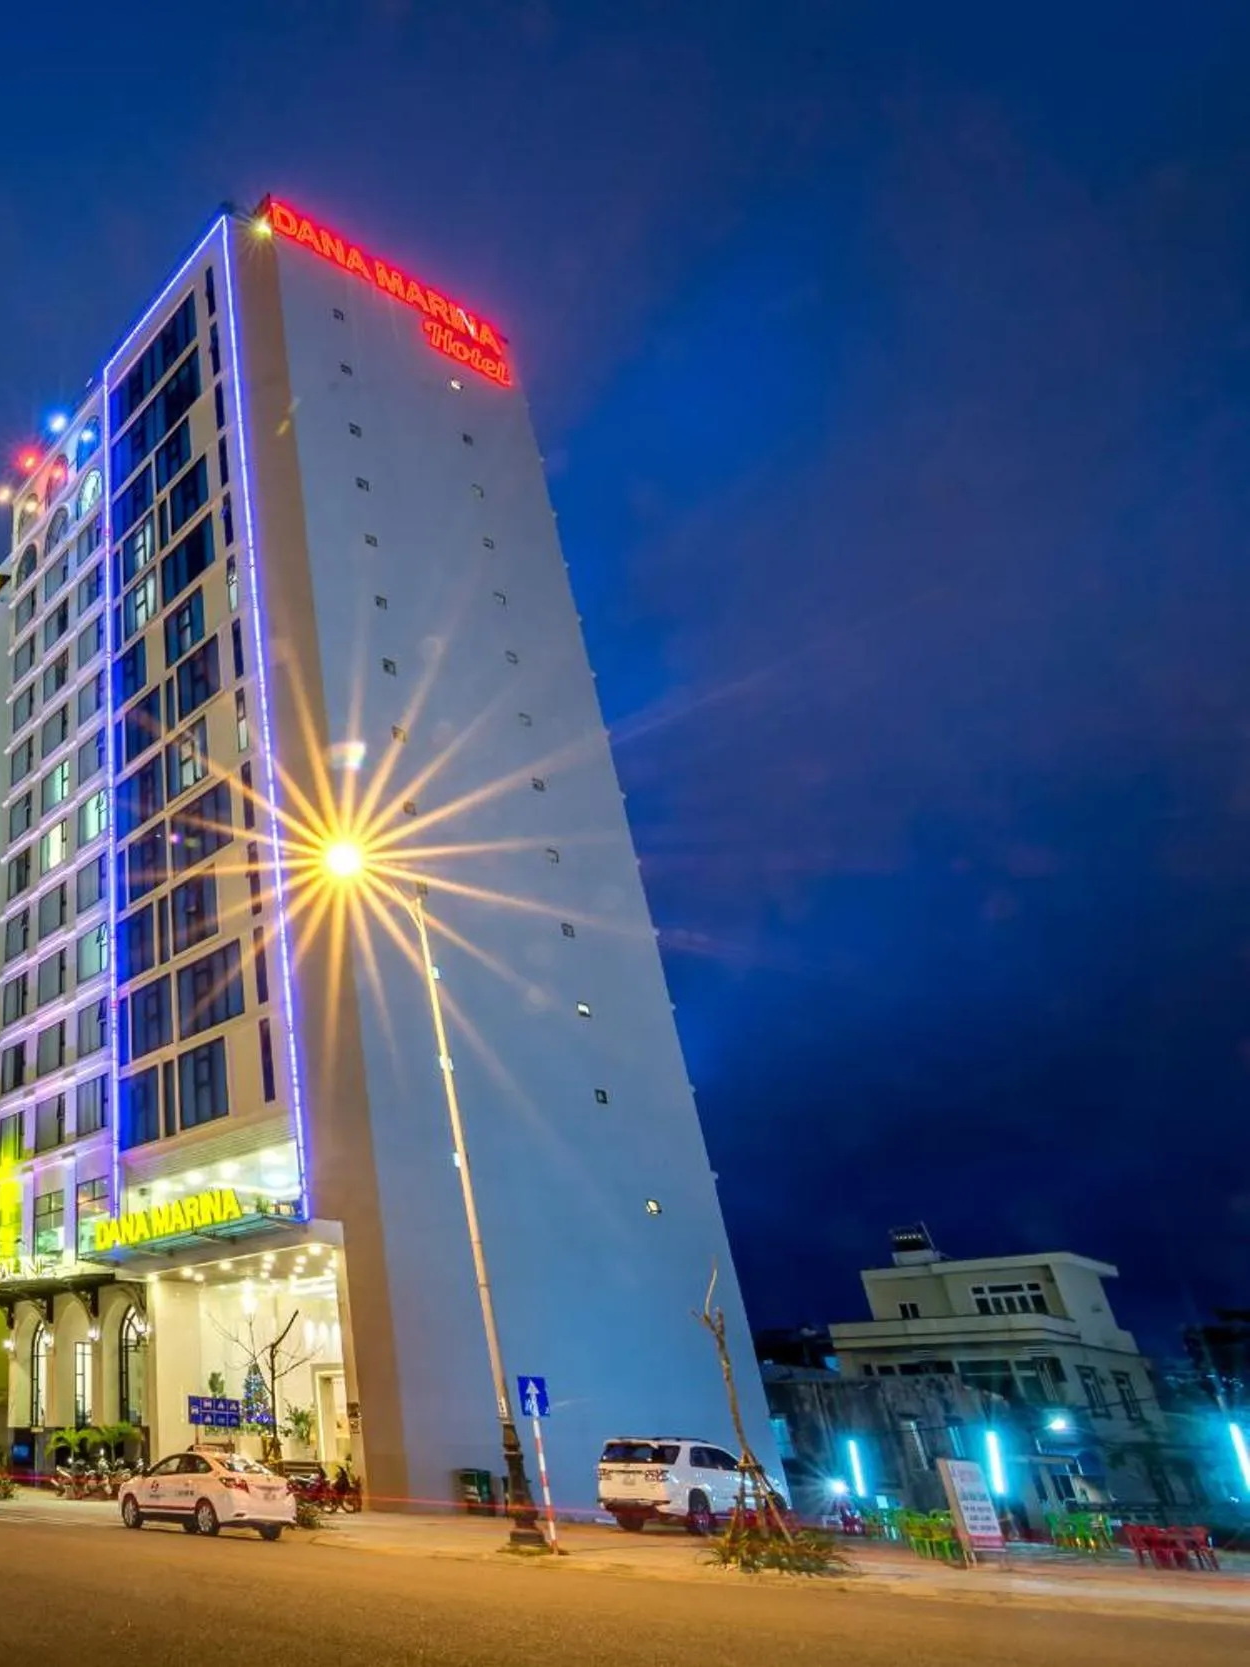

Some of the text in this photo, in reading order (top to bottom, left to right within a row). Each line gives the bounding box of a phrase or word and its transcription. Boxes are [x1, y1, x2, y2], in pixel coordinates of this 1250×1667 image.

[271, 202, 503, 356] DANA MARINA
[423, 319, 513, 387] Hotel
[94, 1187, 243, 1251] DANA MARINA
